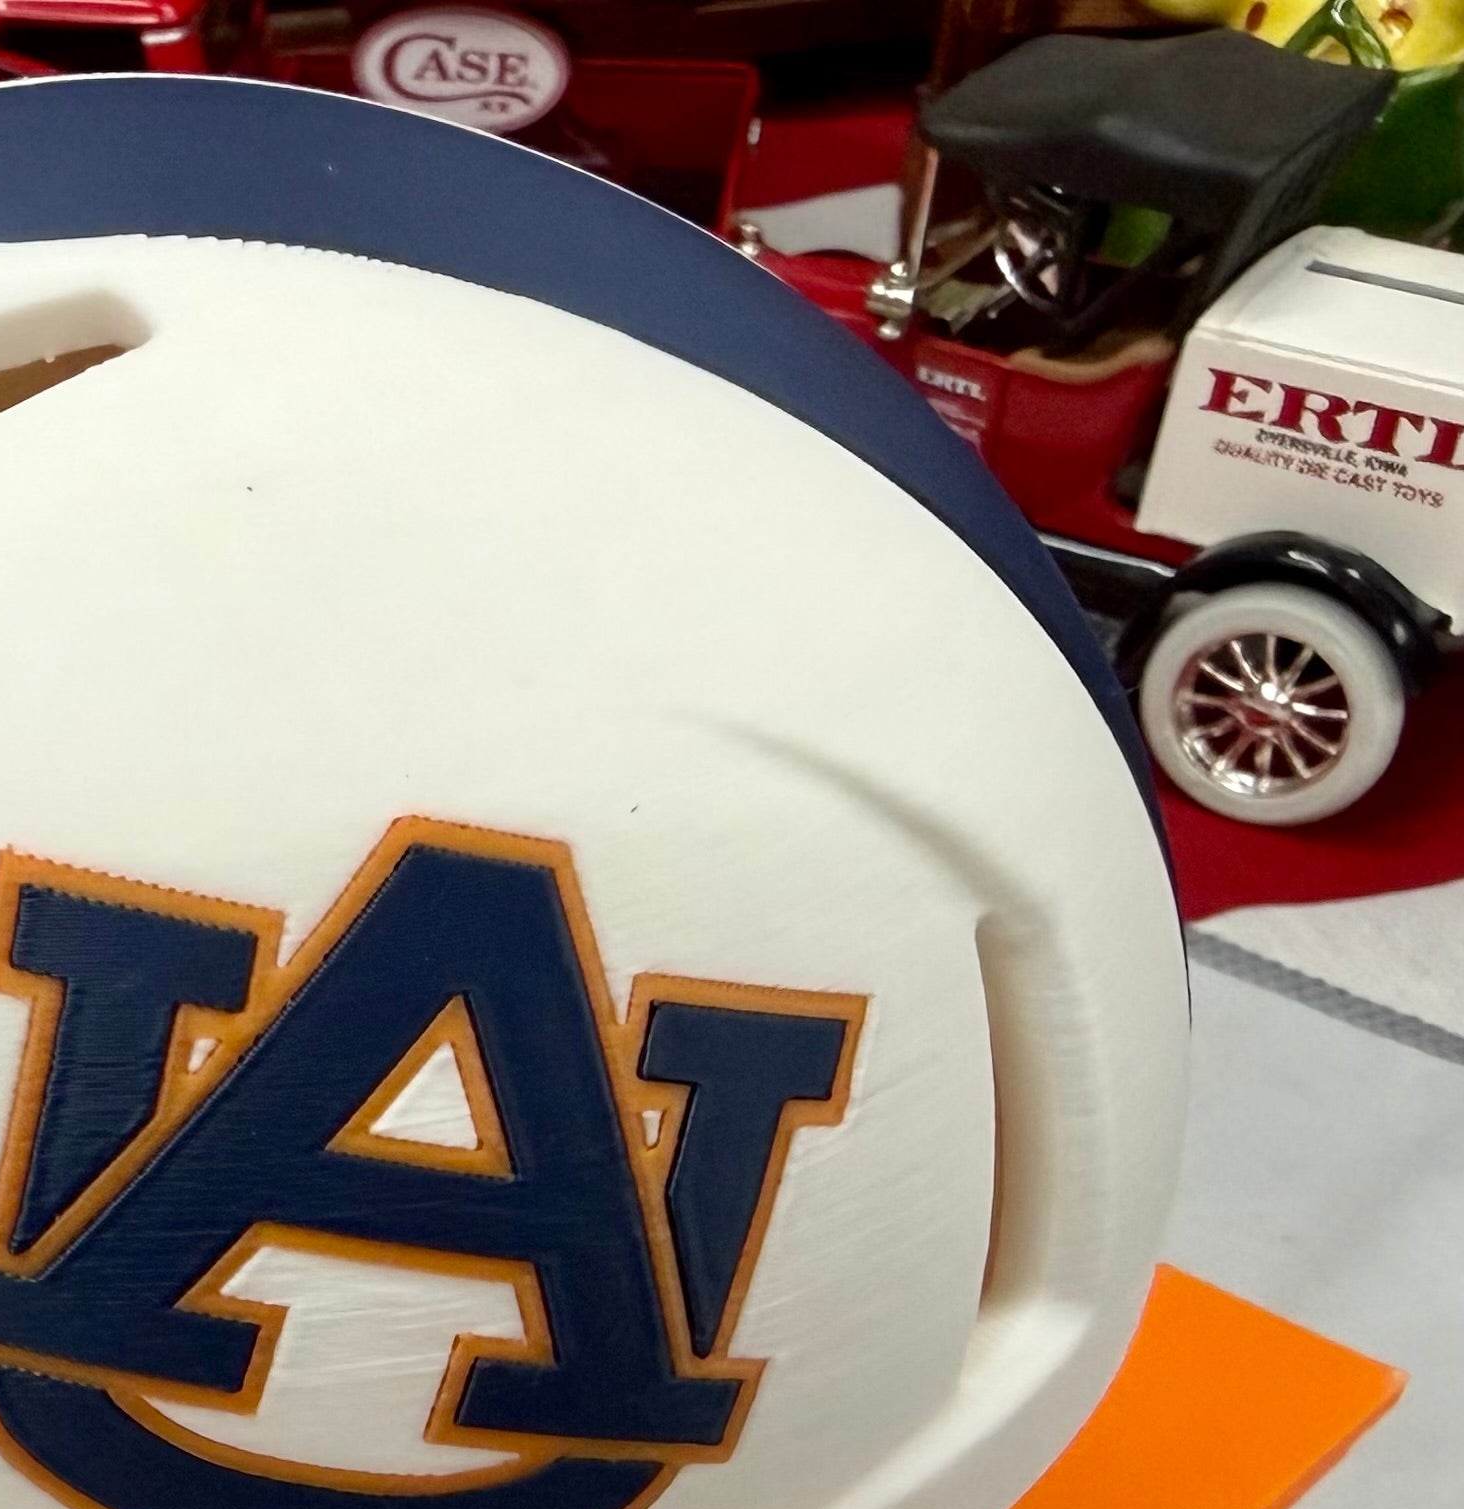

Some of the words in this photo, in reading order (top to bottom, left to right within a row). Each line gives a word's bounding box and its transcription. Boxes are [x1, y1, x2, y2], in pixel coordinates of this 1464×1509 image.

[382, 33, 530, 103] CASE
[1197, 367, 1464, 470] ERTL
[1212, 438, 1294, 474] QUALITY
[1333, 468, 1387, 492] CAST
[1393, 479, 1445, 508] TOYS
